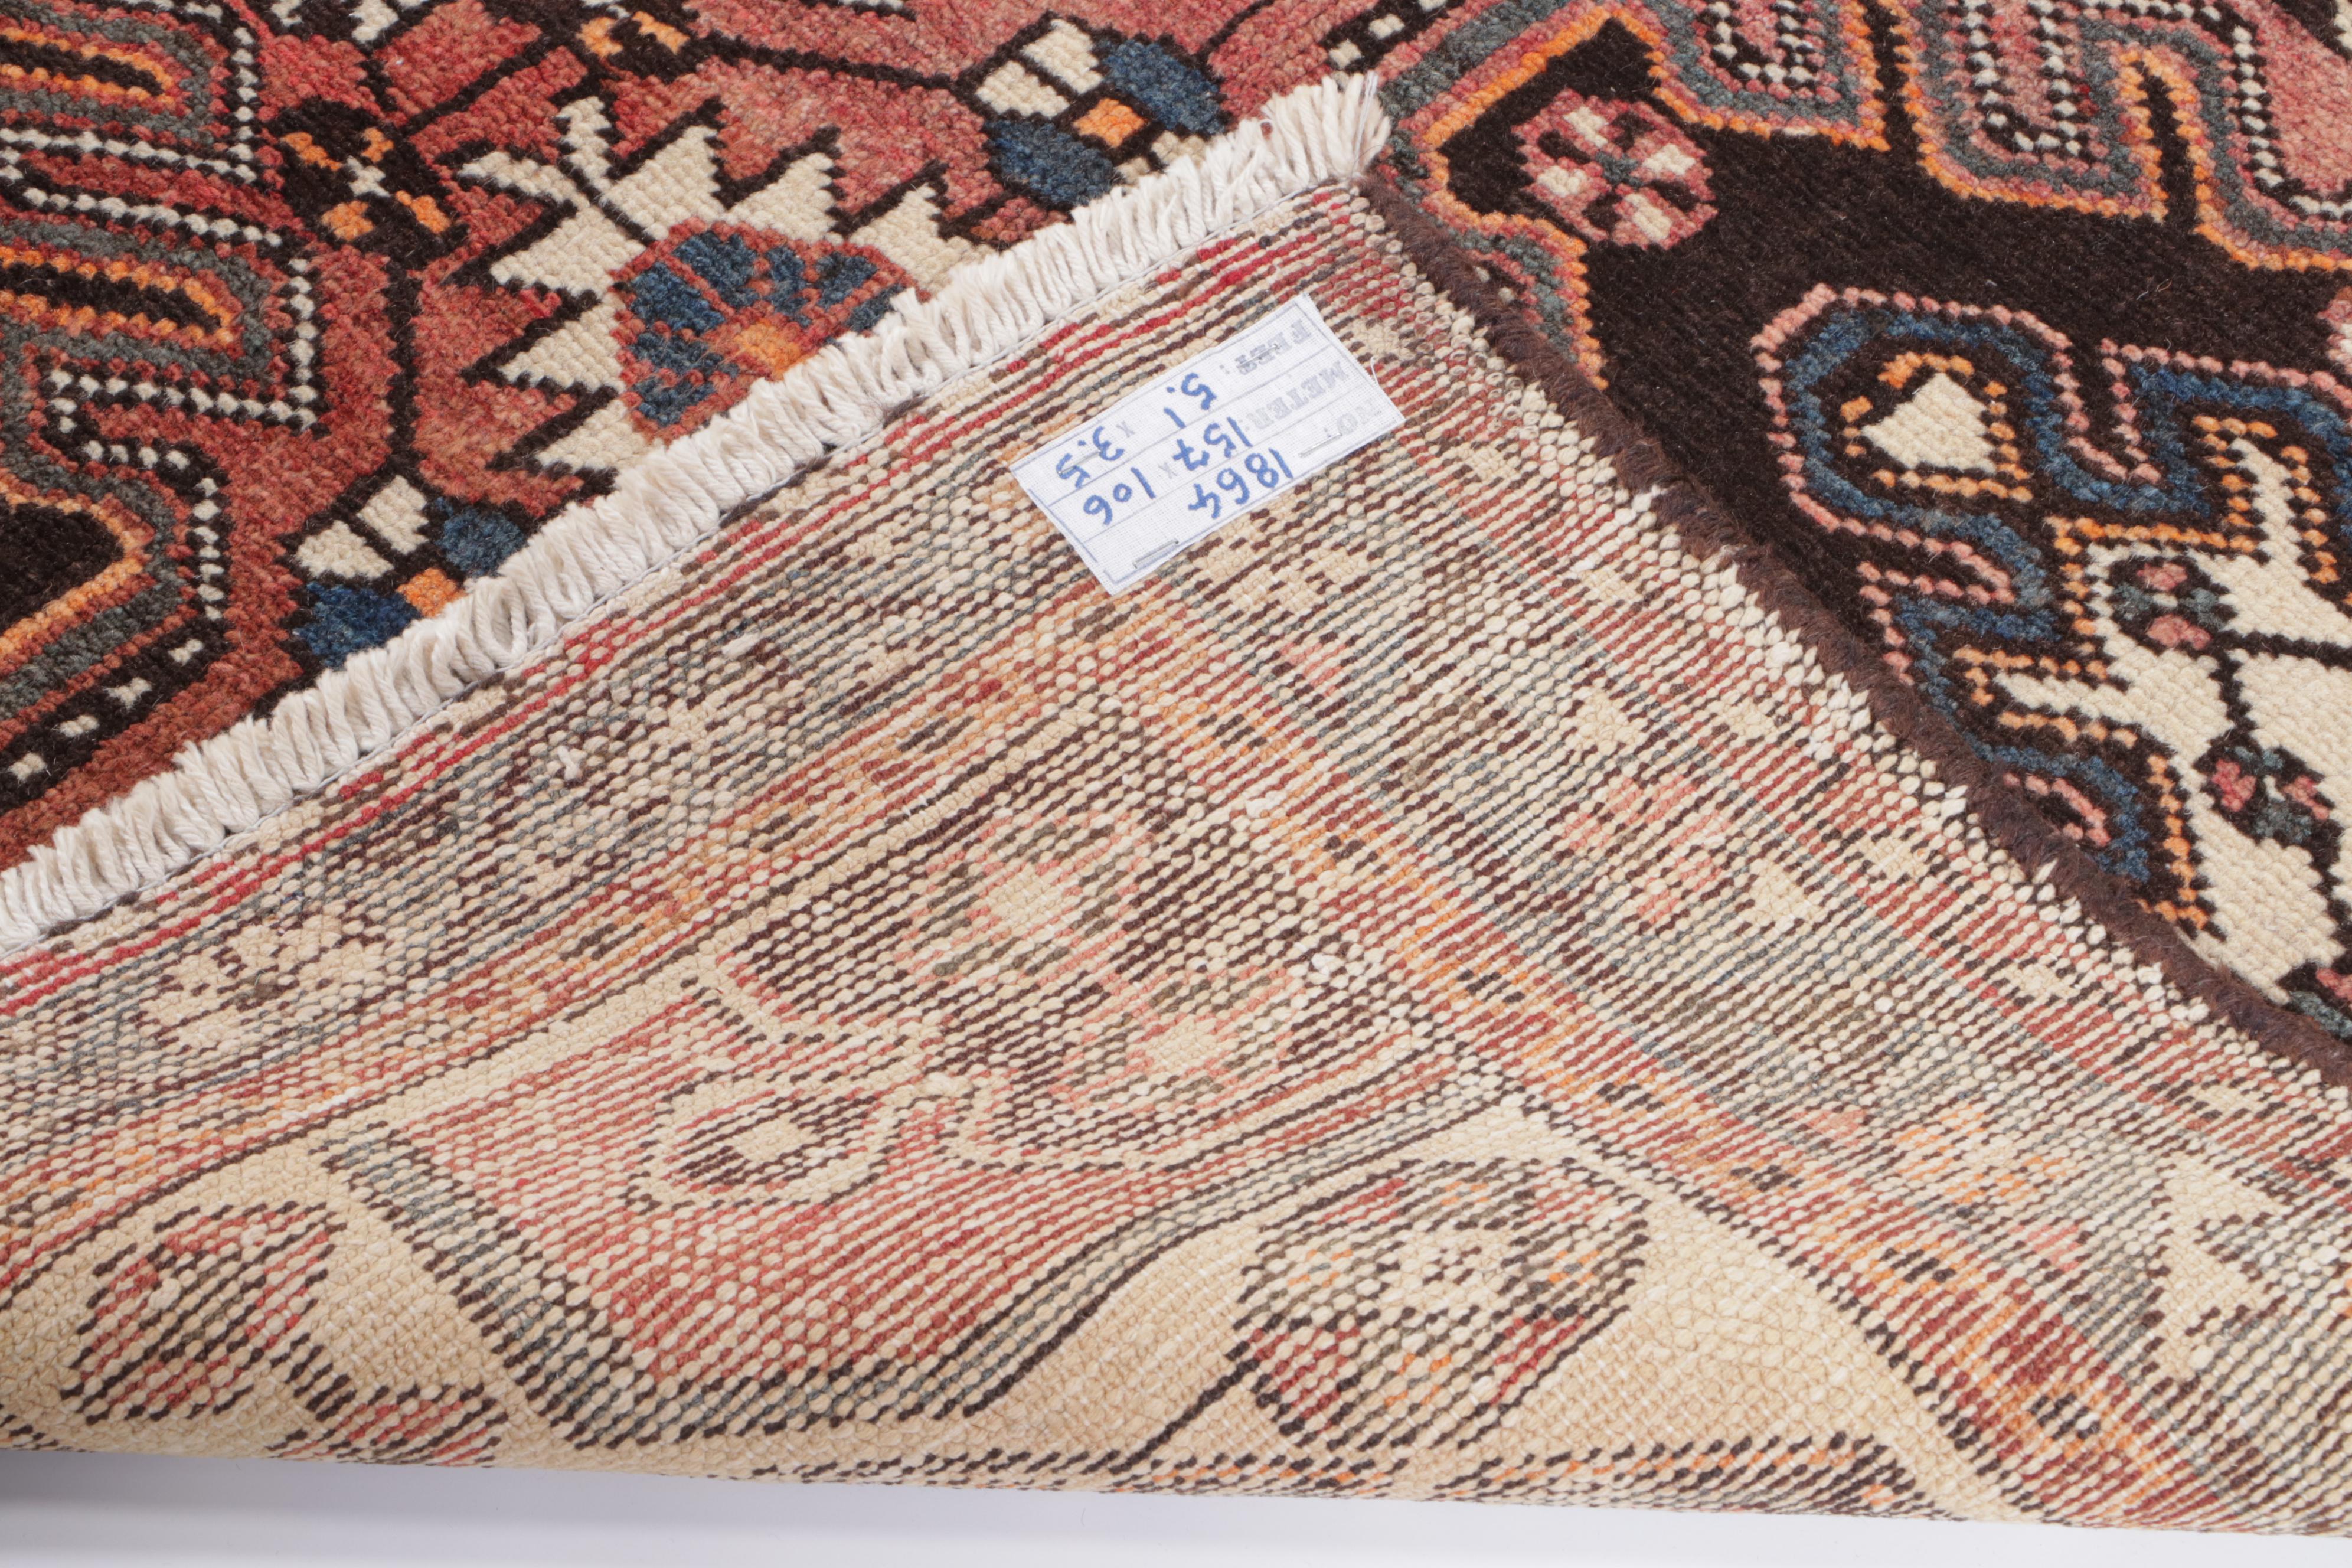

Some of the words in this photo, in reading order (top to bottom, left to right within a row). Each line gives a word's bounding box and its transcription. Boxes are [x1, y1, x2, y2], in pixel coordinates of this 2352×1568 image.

[1056, 425, 1124, 489] 3.5
[1172, 416, 1252, 471] 157
[1083, 466, 1156, 525] 106
[1187, 447, 1294, 519] 1864
